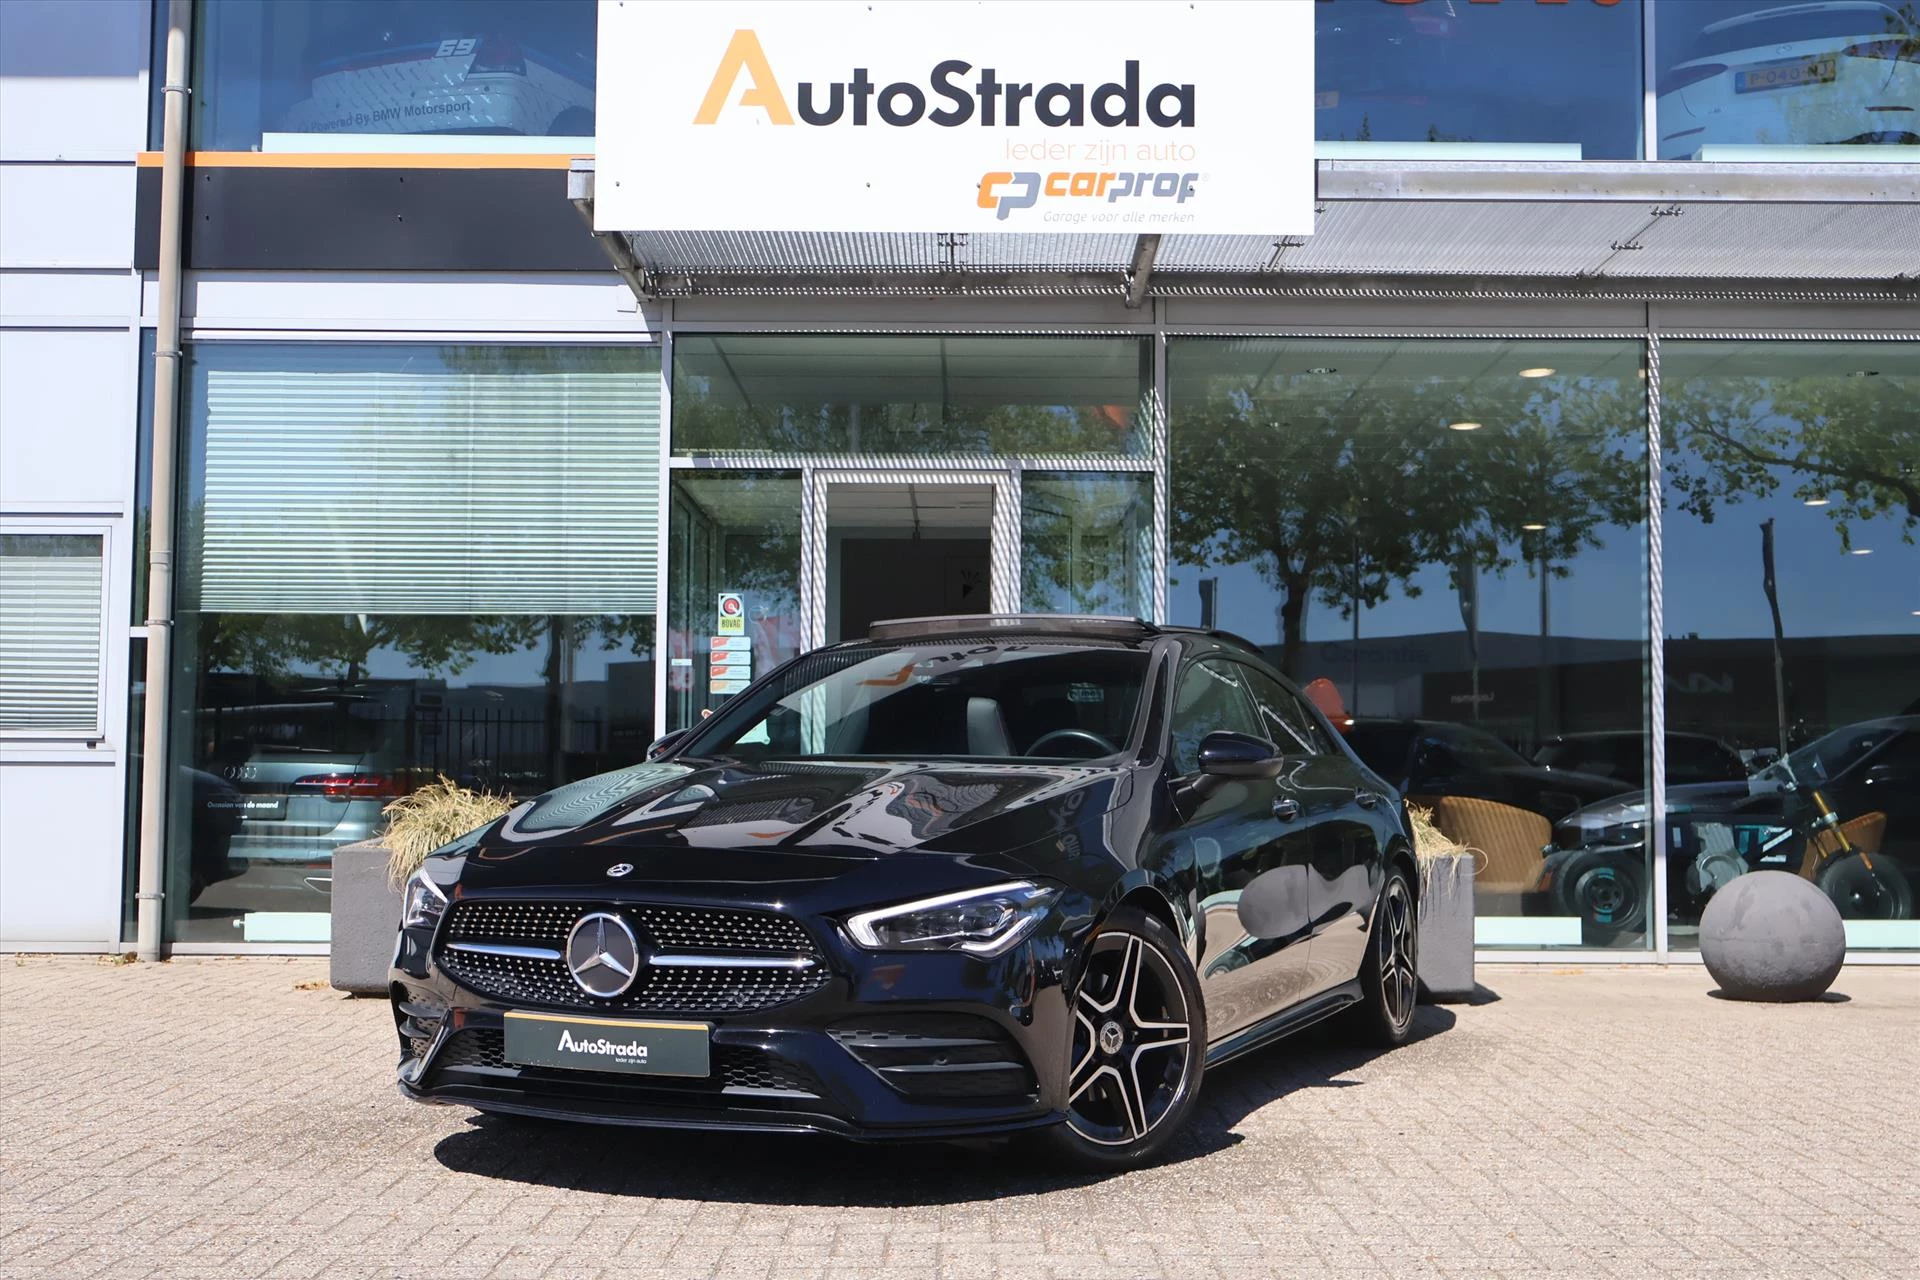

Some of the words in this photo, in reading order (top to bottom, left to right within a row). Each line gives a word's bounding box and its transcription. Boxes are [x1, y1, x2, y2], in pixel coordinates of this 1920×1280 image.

[435, 39, 477, 57] 69
[692, 28, 1196, 127] AutoStrada
[310, 111, 353, 132] Powered
[355, 112, 371, 126] By
[373, 107, 400, 122] BMW
[404, 100, 472, 117] Motorsport
[1006, 138, 1077, 161] Ieder
[1084, 139, 1127, 166] zijn
[1136, 141, 1196, 161] auto
[1044, 171, 1199, 204] carprof
[1043, 211, 1088, 224] Garage
[1092, 212, 1119, 223] voor
[1122, 210, 1146, 222] alle
[1149, 211, 1195, 223] merken
[721, 619, 741, 629] BOVAG
[246, 801, 255, 809] de
[256, 801, 279, 809] maand
[557, 1029, 648, 1057] AutoStrada
